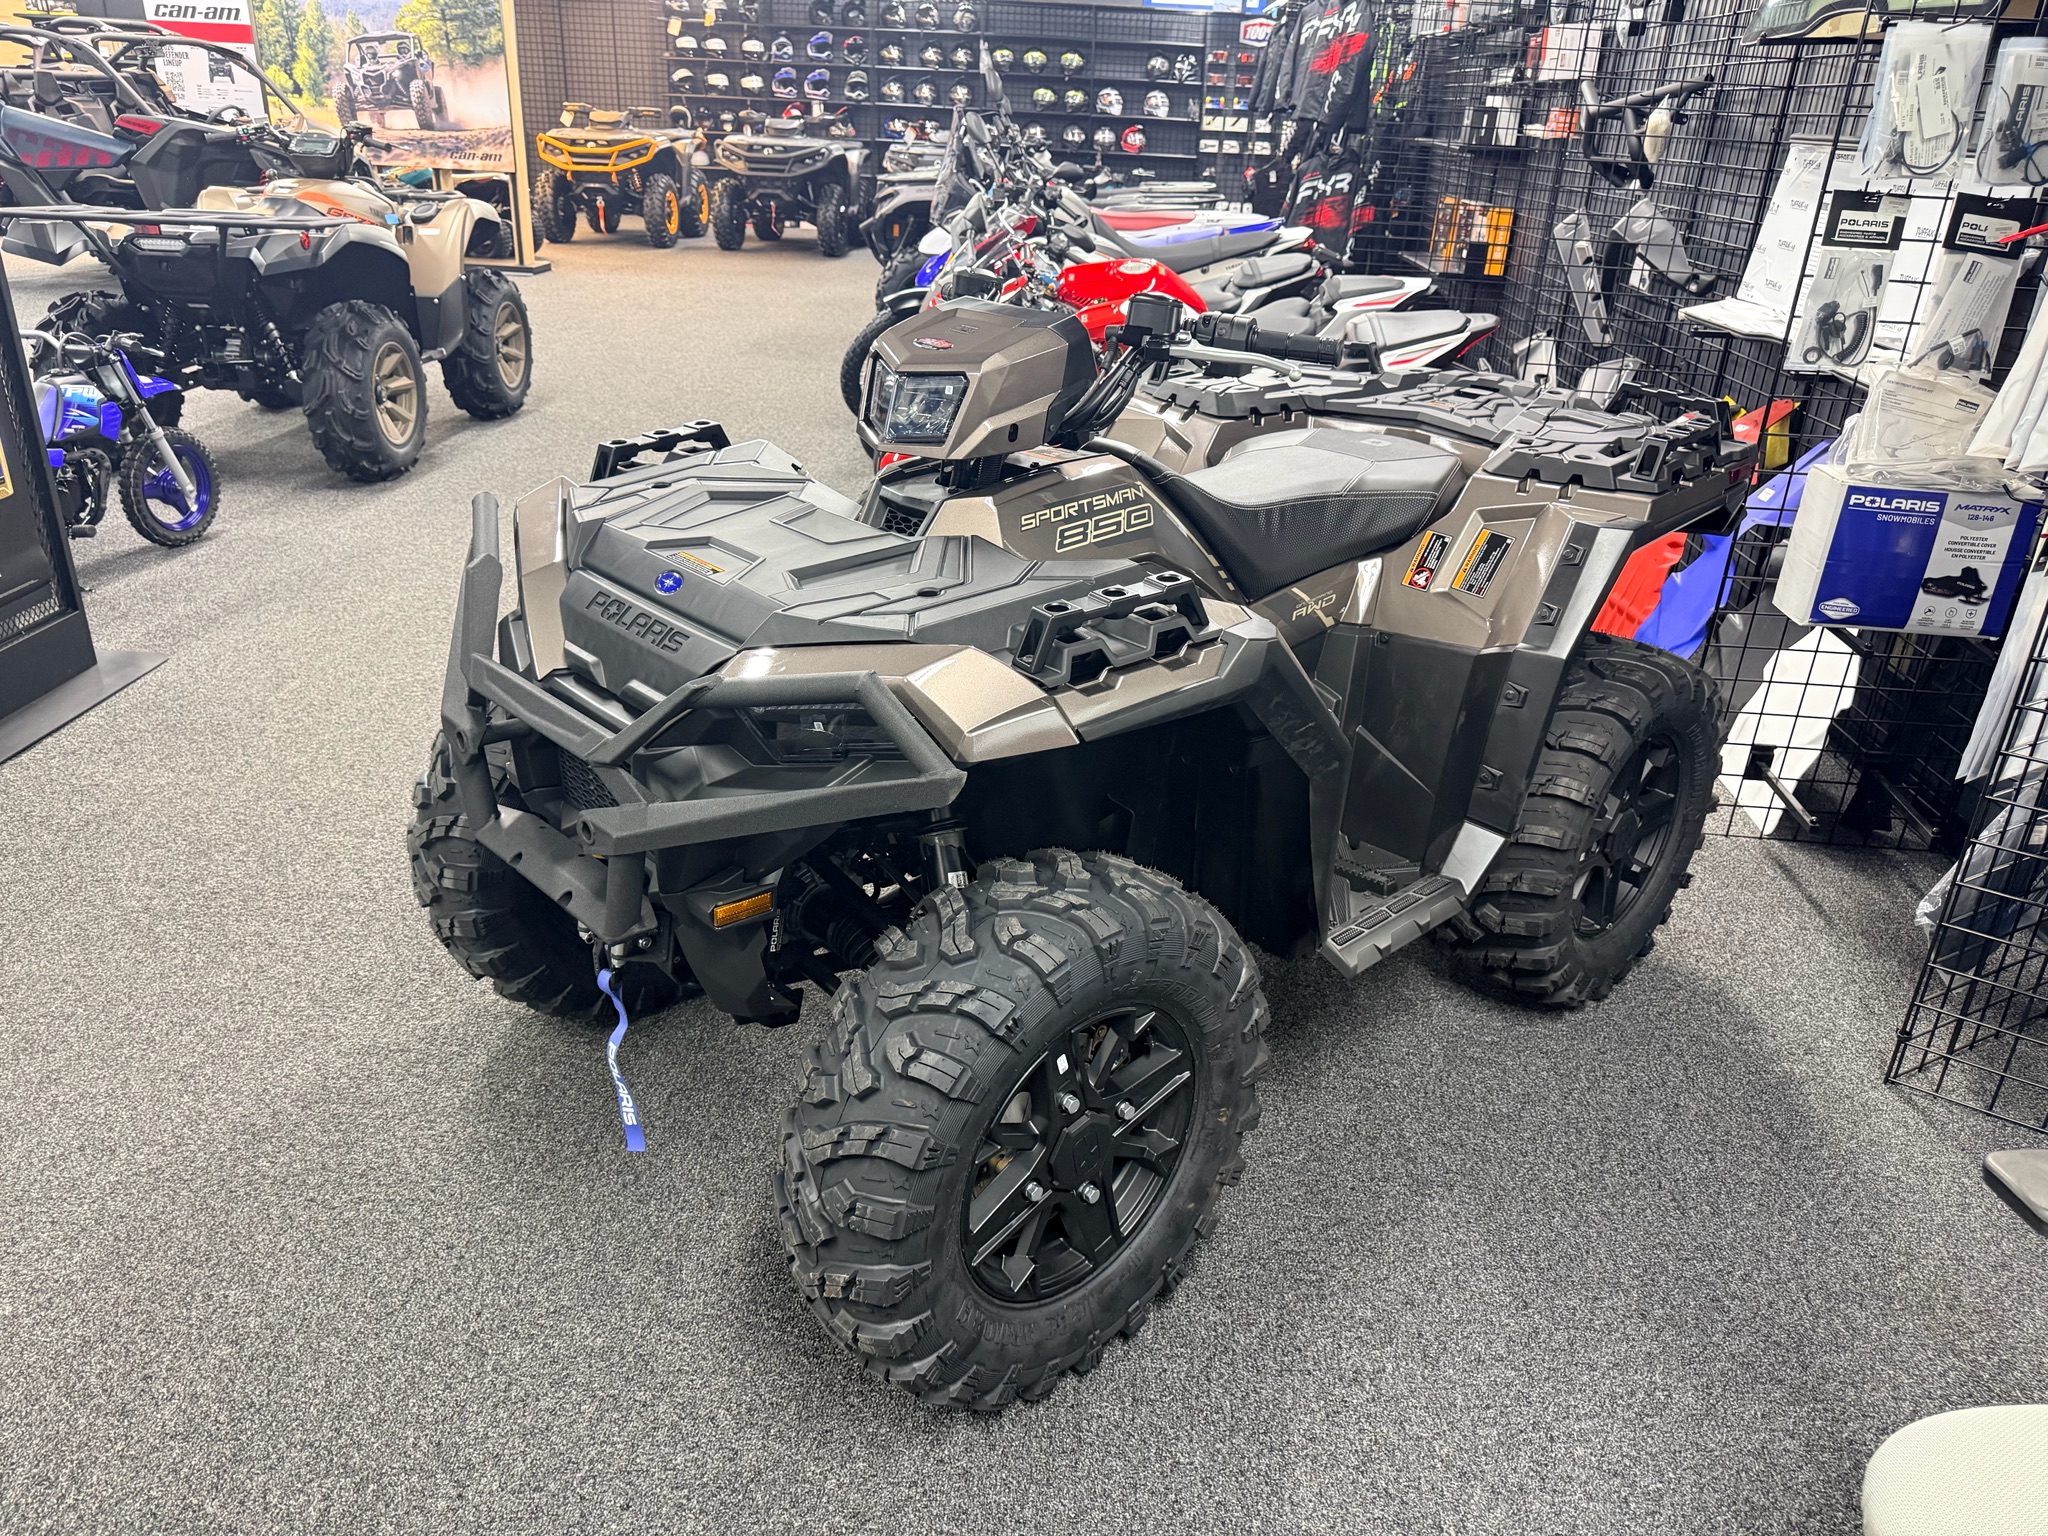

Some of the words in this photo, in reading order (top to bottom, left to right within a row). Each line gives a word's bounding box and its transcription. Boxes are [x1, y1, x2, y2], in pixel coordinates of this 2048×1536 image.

[154, 3, 241, 21] can-am
[450, 150, 503, 162] can-am
[1296, 172, 1353, 205] FXR
[1840, 218, 1890, 228] POLARIS
[1021, 485, 1144, 531] SPORTSMAN
[1849, 494, 1941, 513] POLARIS
[1954, 504, 2012, 515] MATRYX
[1876, 513, 1936, 525] SNOWMOBILES
[1967, 514, 1995, 522] 128-146
[1055, 503, 1154, 553] 850
[1465, 544, 1480, 569] WARNING
[1956, 581, 1976, 590] POLARIS
[1292, 593, 1336, 622] AWD
[1820, 604, 1858, 613] ENGINEERED
[585, 591, 691, 655] POLARIS
[609, 1041, 638, 1126] POLARIS
